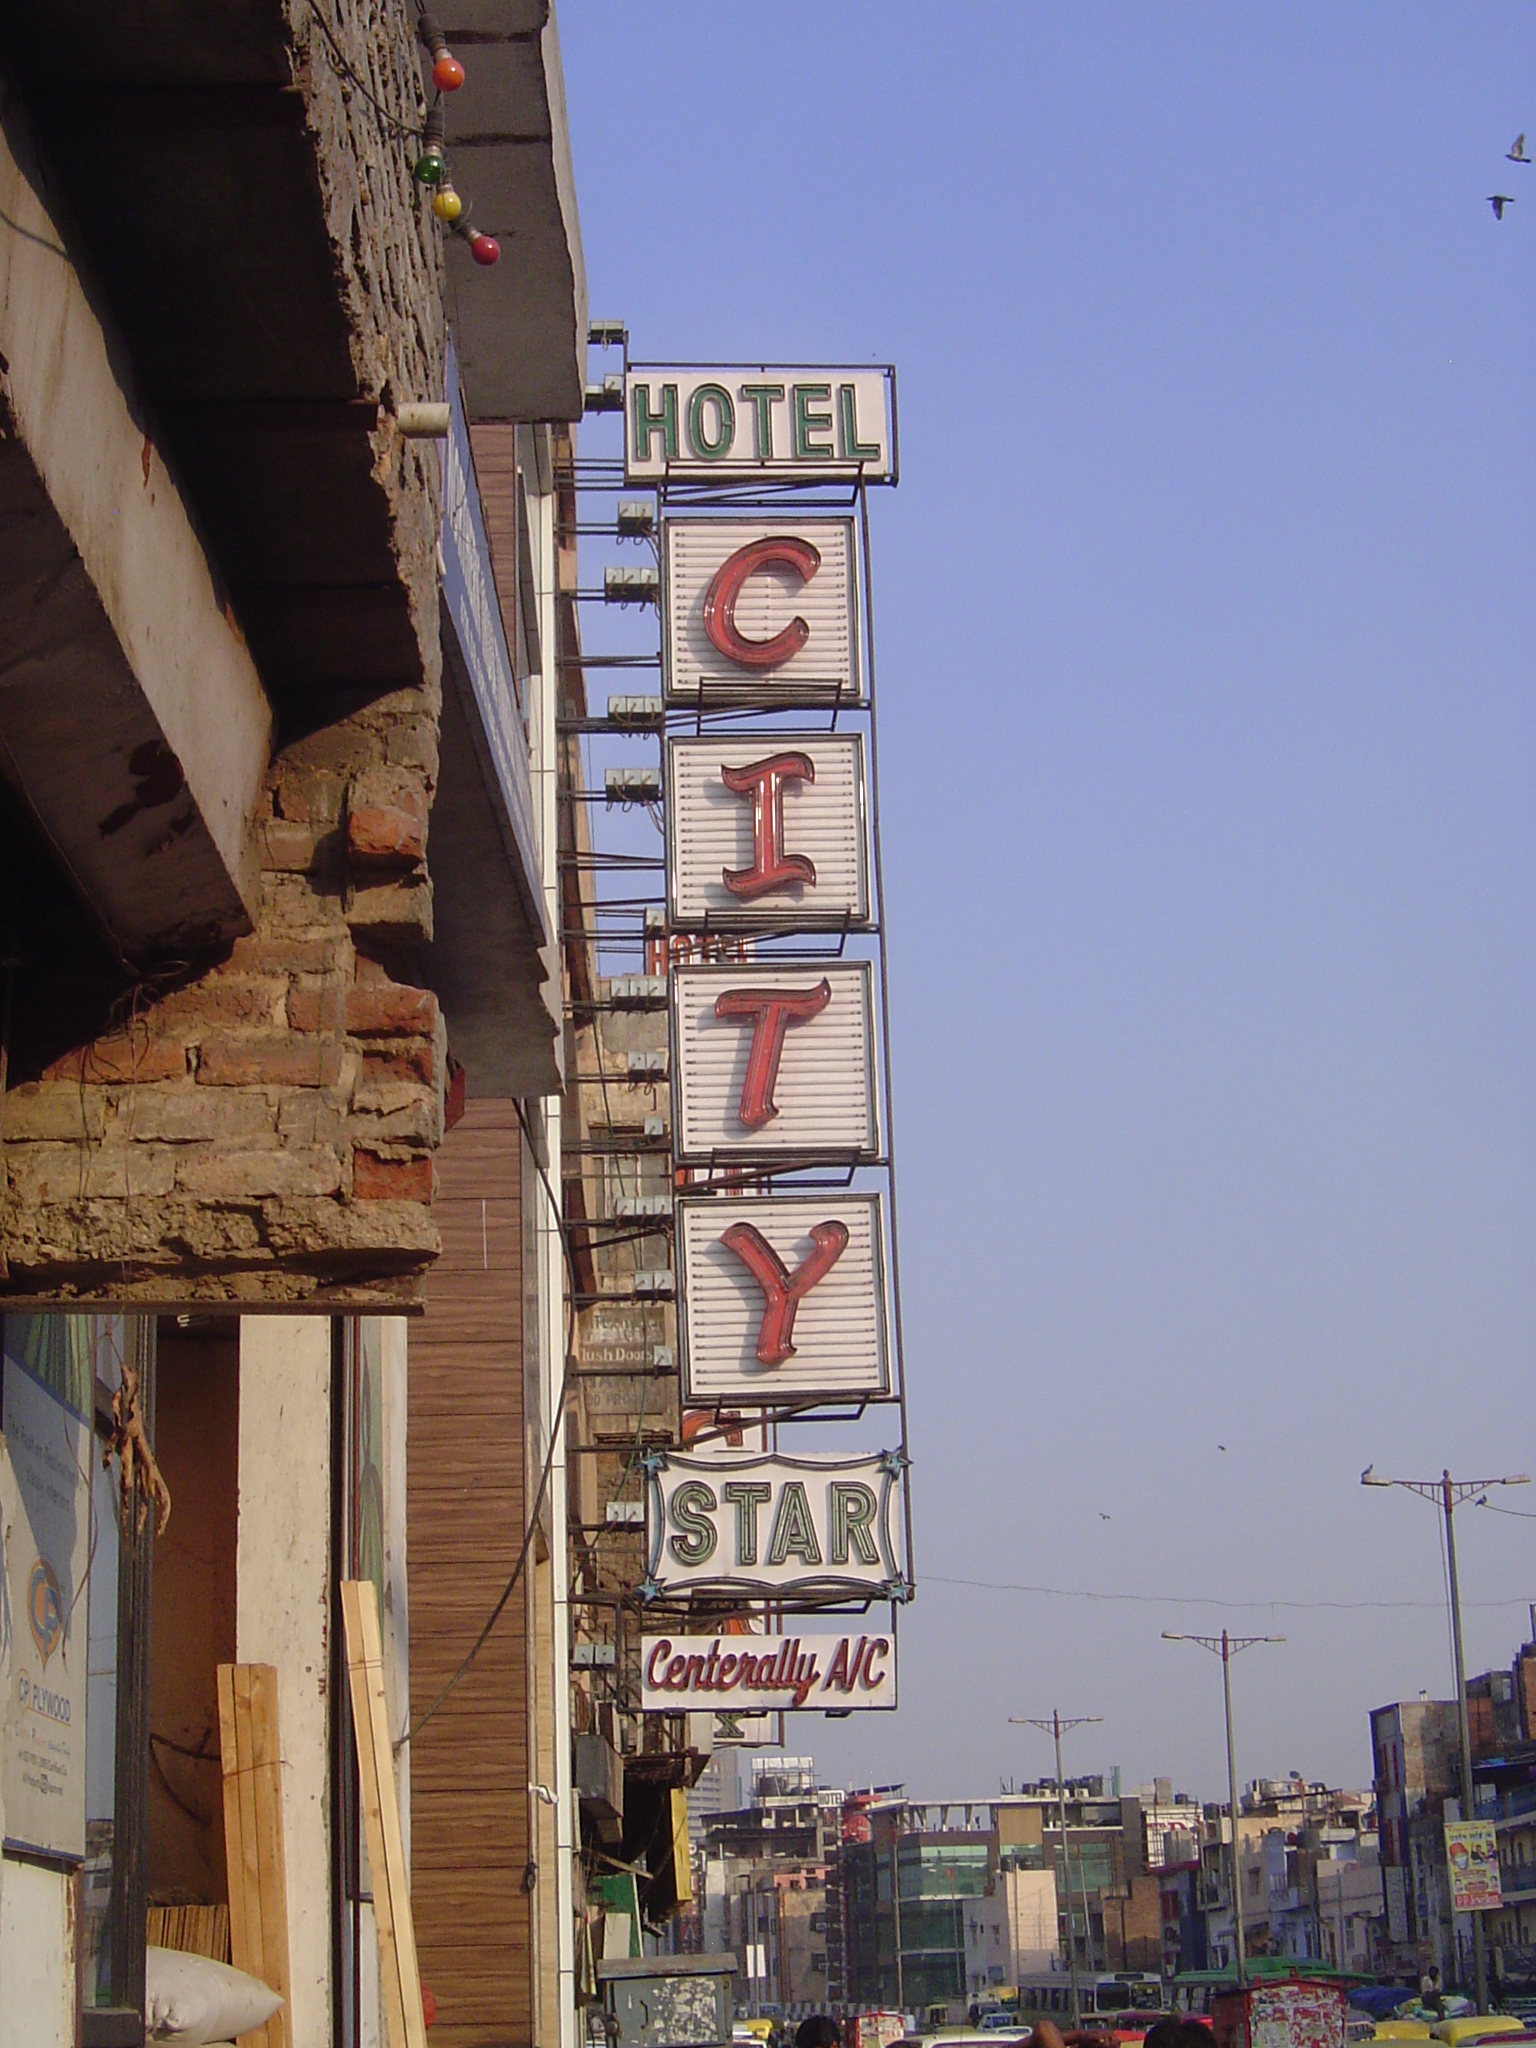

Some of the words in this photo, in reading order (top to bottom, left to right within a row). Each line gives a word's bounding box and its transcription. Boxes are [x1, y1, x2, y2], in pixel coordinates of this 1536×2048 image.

[633, 383, 882, 461] HOTEL
[703, 536, 850, 1364] CITY
[671, 1480, 880, 1566] STAR
[18, 1677, 29, 1703] CP
[32, 1684, 71, 1722] PLYWOOD
[648, 1638, 821, 1706] Centerally
[821, 1635, 890, 1692] A/C
